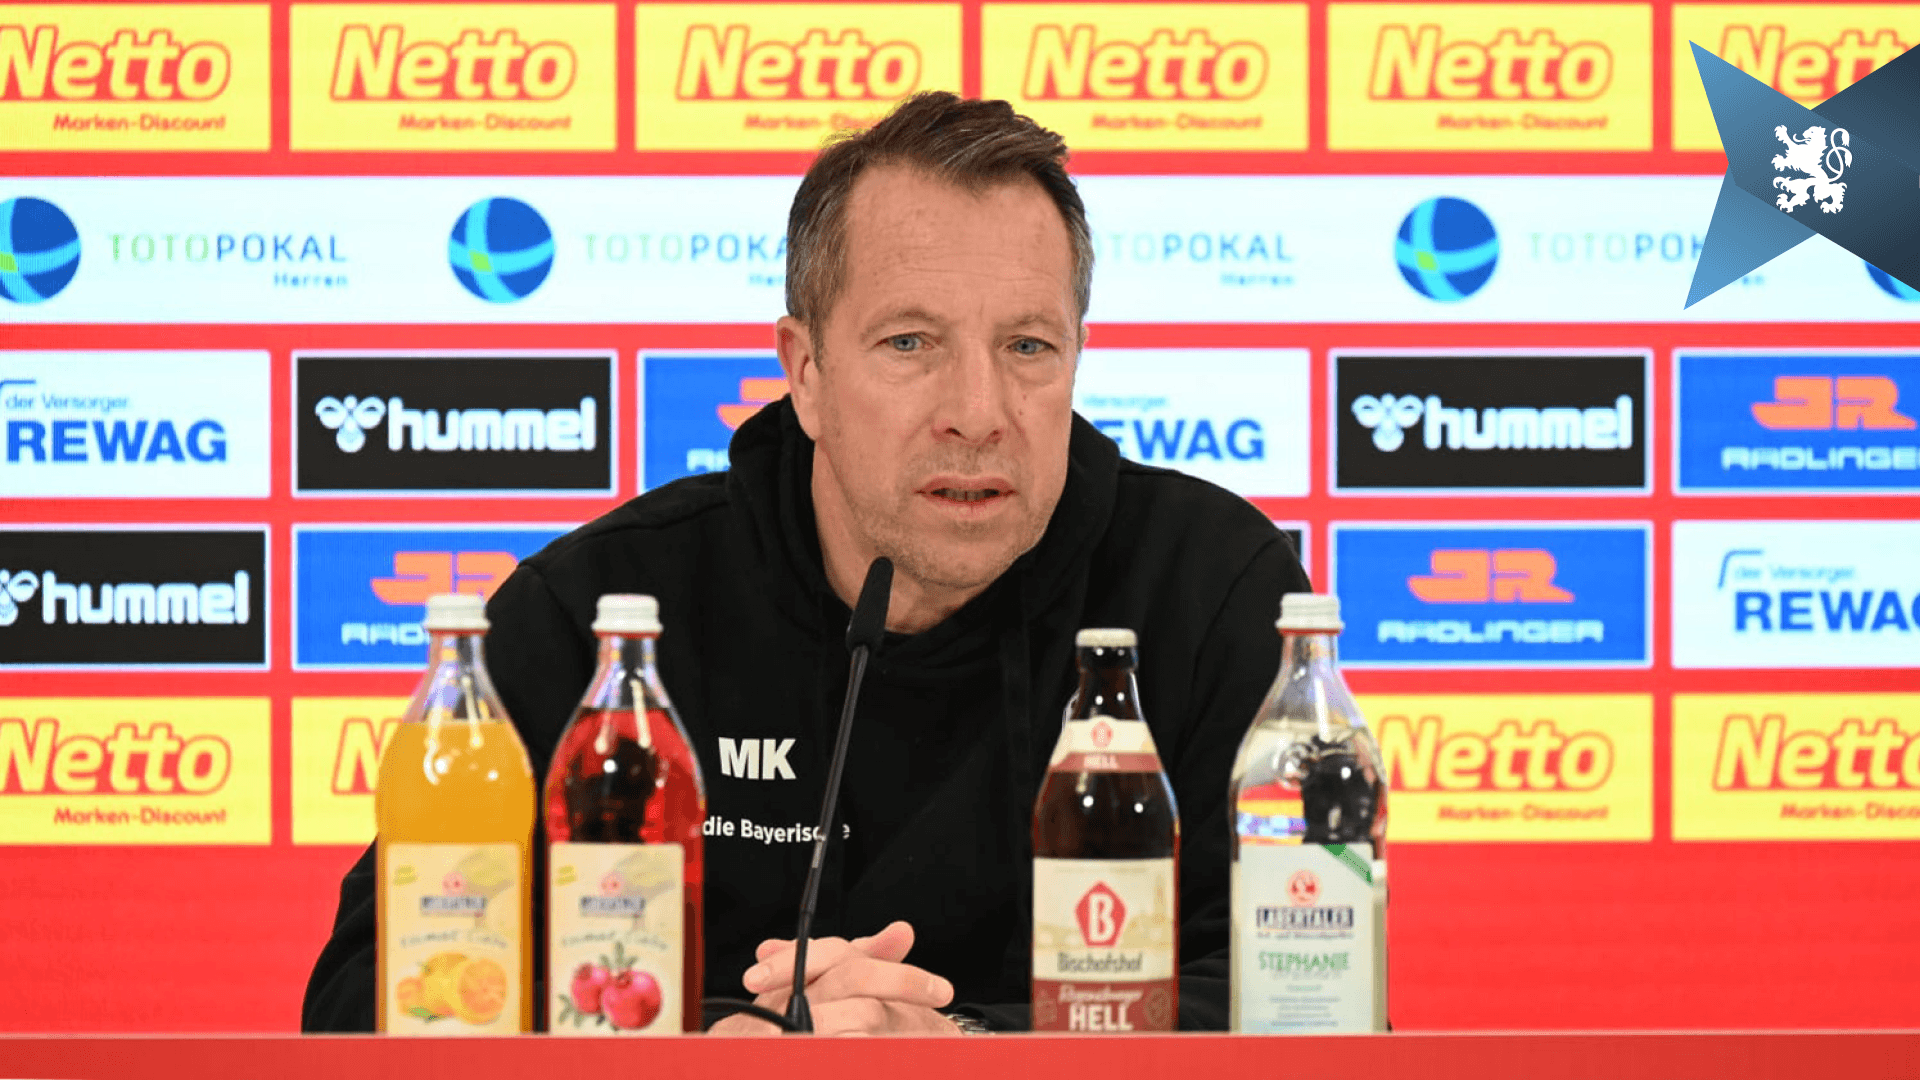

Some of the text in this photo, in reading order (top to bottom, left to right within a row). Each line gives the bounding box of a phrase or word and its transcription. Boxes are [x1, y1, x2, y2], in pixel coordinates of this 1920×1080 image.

[0, 24, 231, 102] Netto
[330, 24, 577, 102] Netto
[675, 24, 922, 102] Netto
[1022, 24, 1268, 102] Netto
[1368, 24, 1614, 102] Netto
[1719, 24, 1910, 102] Nett
[53, 113, 226, 131] Marken-Discount
[399, 113, 571, 131] Marken-Discount
[109, 233, 348, 263] TOTOPOKAL
[583, 232, 787, 264] TOTOPOKA
[1091, 232, 1294, 264] TOPOKAL
[272, 271, 349, 288] Herren
[6, 418, 228, 464] REWAG
[388, 397, 596, 451] hummel
[1423, 395, 1633, 450] hummel
[42, 571, 250, 624] hummel
[1734, 590, 1920, 632] REWA
[0, 717, 232, 796] Netto
[718, 737, 796, 780] MK
[1379, 715, 1614, 793] Netto
[54, 806, 226, 824] Marken-Discount
[702, 815, 735, 836] die
[1780, 801, 1920, 820] Marken-Disco
[1089, 894, 1115, 943] B
[1057, 951, 1143, 971] Bischofshof
[1068, 1004, 1133, 1031] HELL
